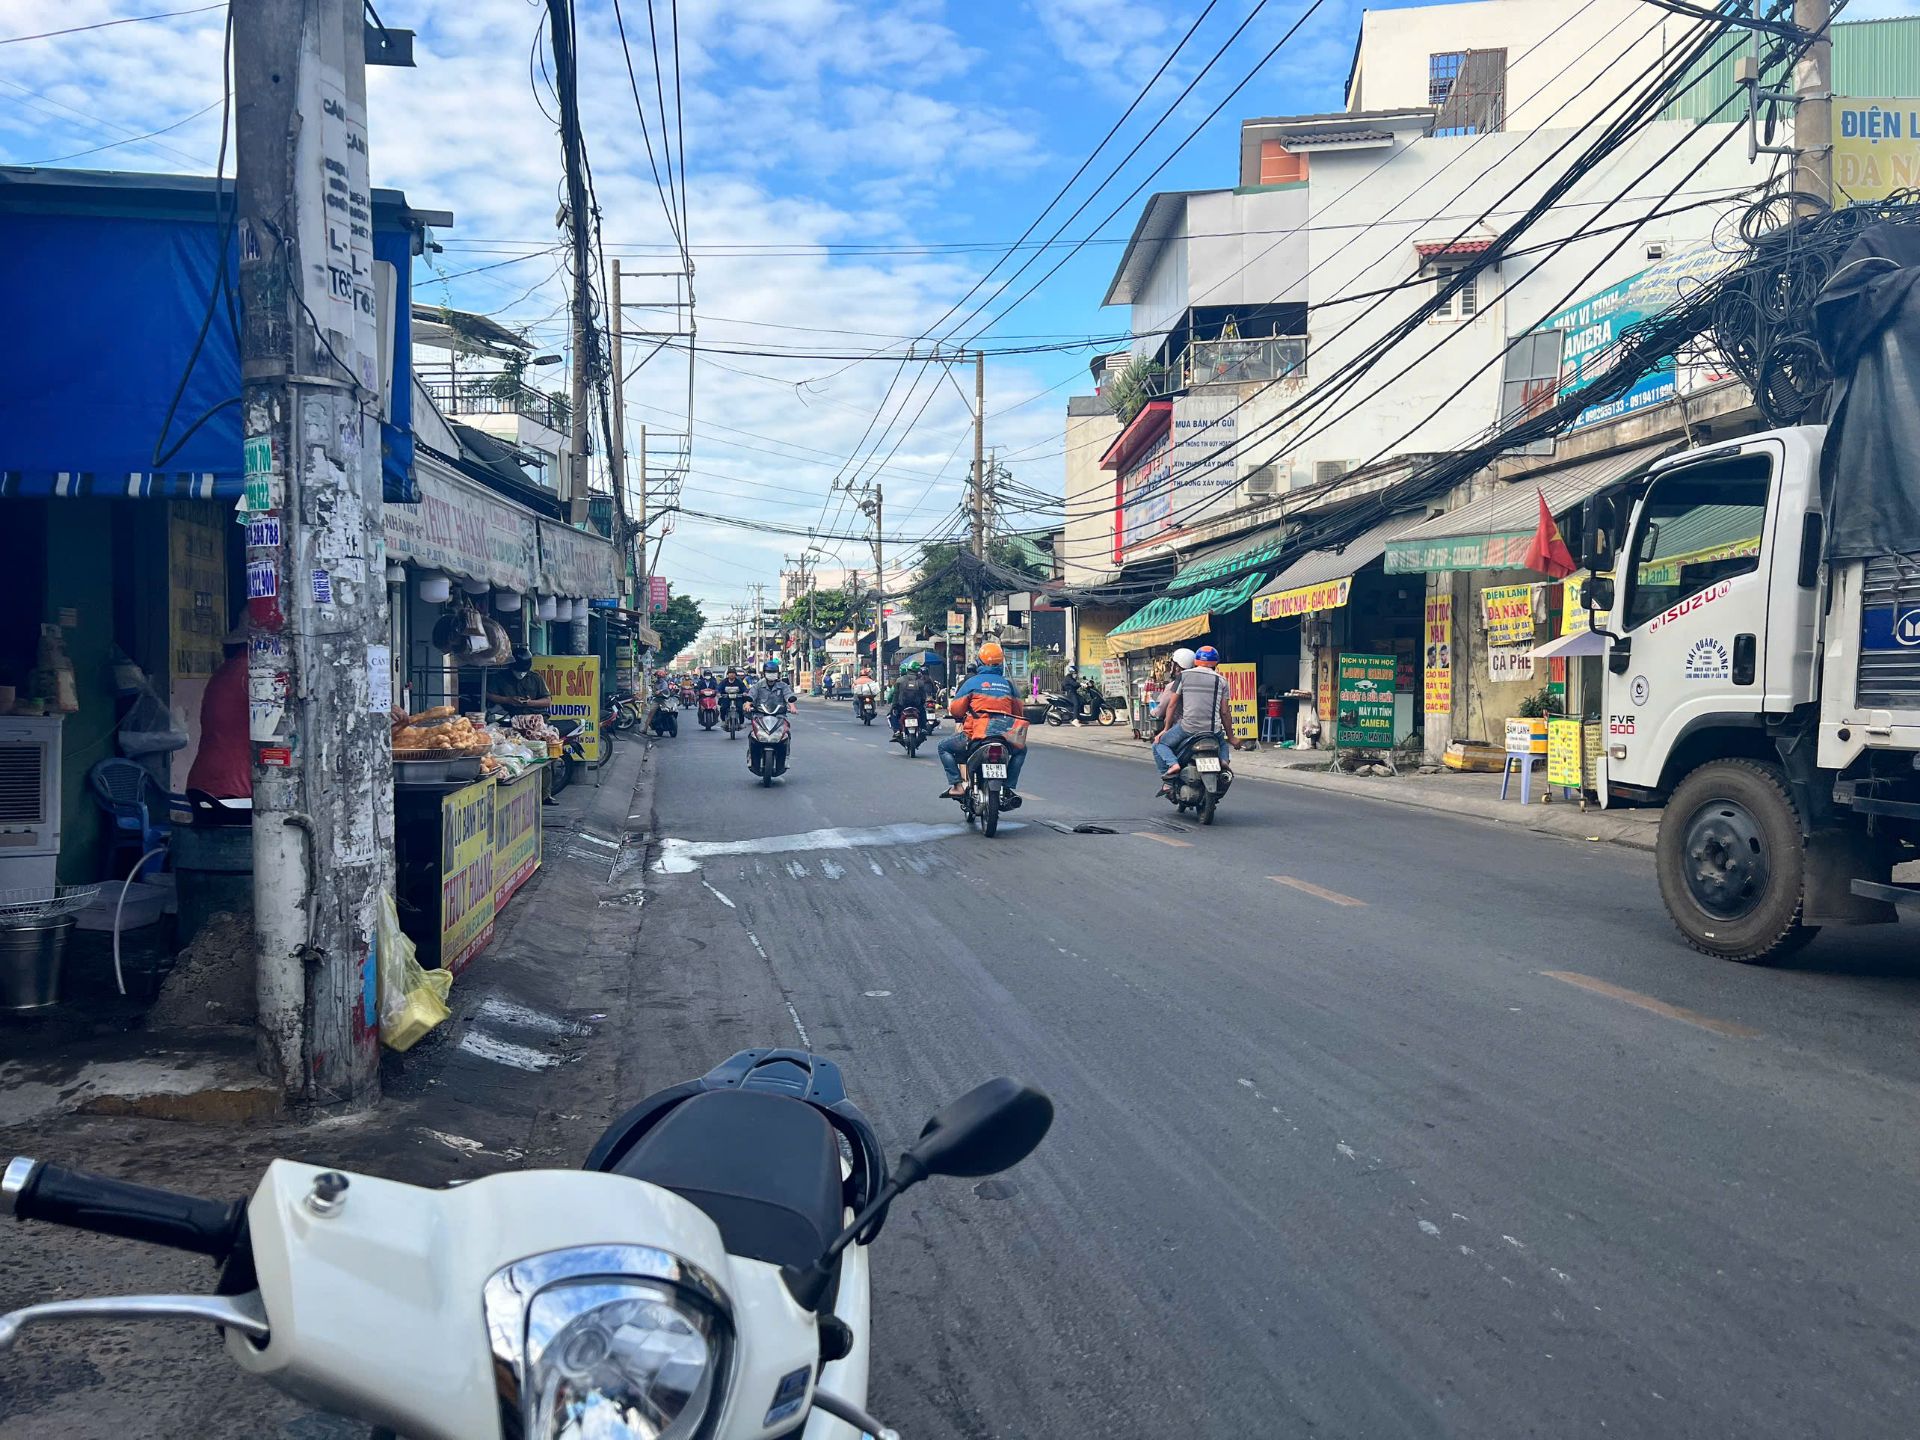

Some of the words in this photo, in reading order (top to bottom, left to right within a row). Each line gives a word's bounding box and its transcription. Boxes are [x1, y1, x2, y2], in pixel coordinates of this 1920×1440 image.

[1841, 106, 1901, 144] ĐIỆN
[1563, 319, 1612, 361] AMERA
[1175, 420, 1191, 428] MUA
[1661, 588, 1716, 625] ISUZU
[1695, 637, 1718, 651] QUANG
[1240, 671, 1255, 700] NAM
[547, 704, 590, 716] AUNDRY)
[1360, 718, 1390, 728] CAMERA
[1610, 715, 1635, 725] FVR
[1610, 725, 1635, 734] 900
